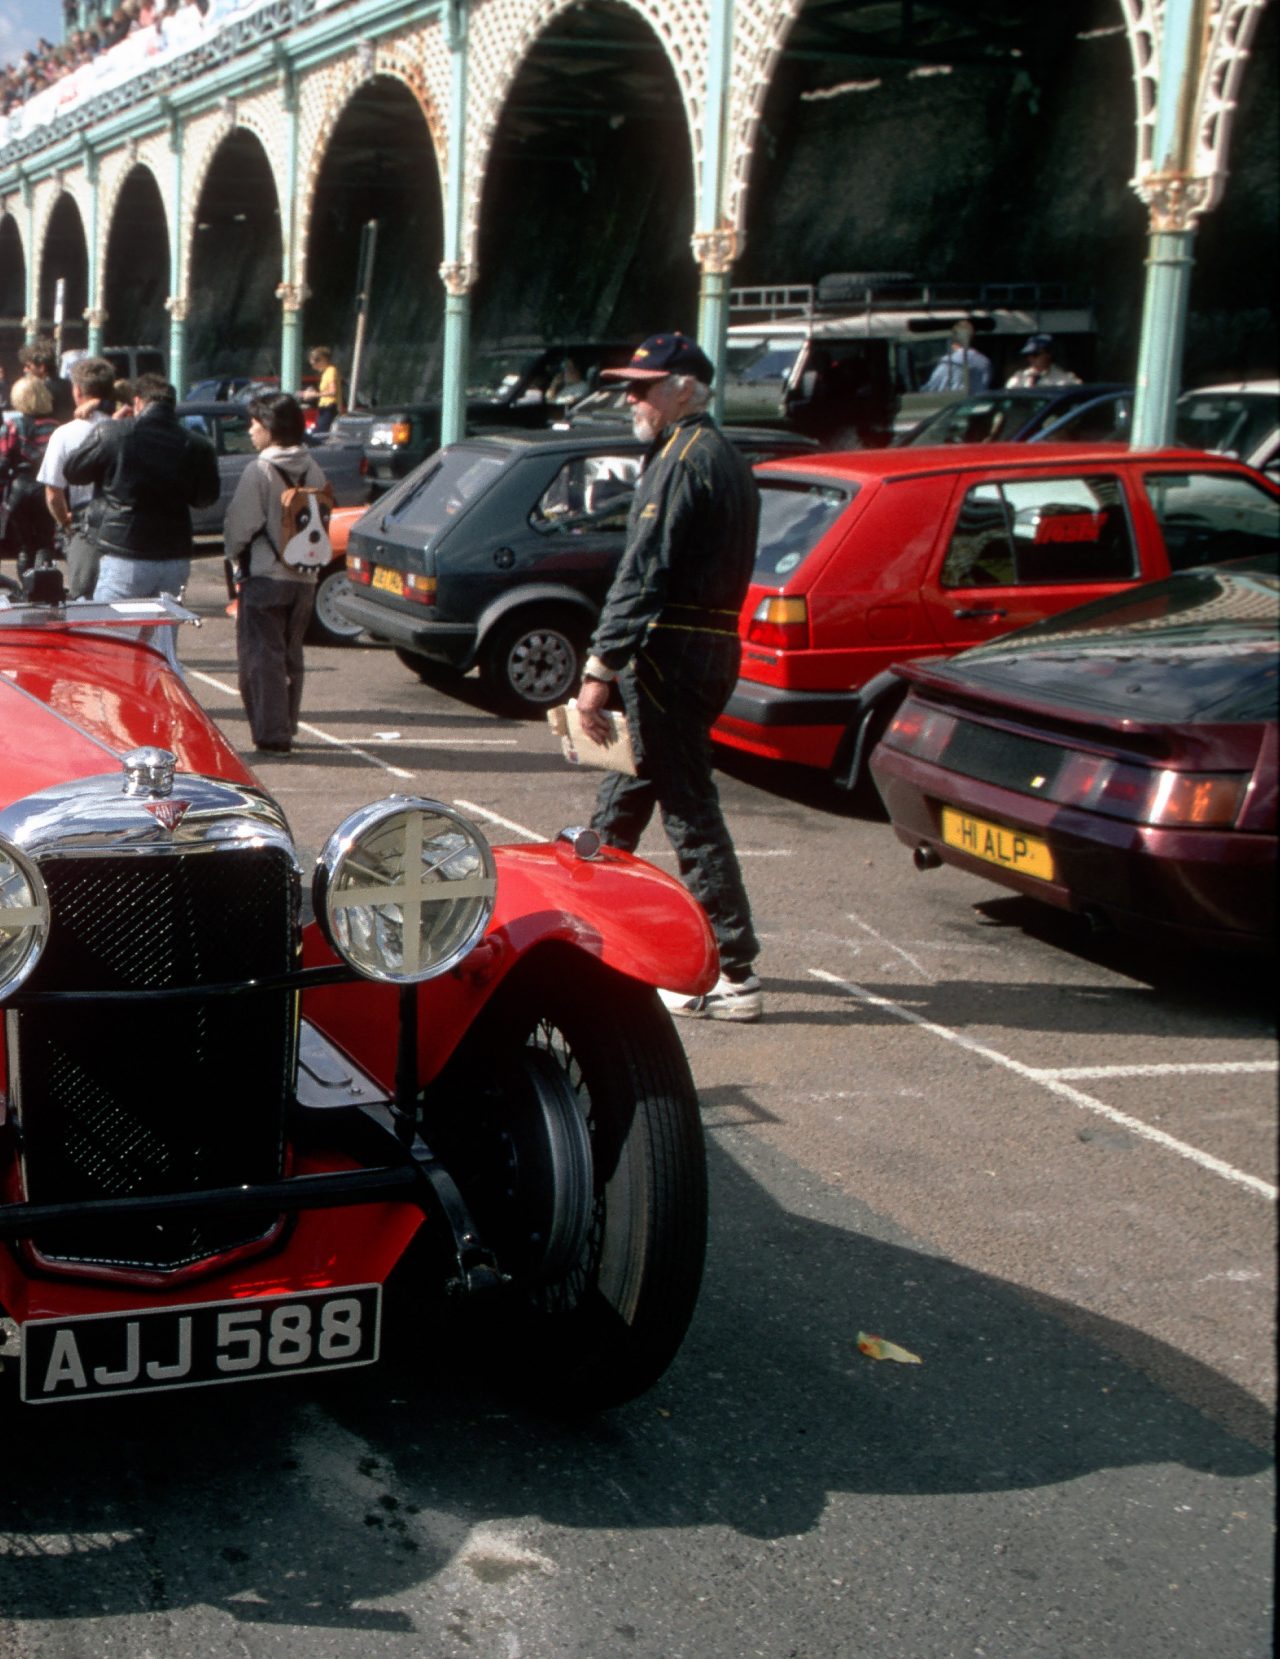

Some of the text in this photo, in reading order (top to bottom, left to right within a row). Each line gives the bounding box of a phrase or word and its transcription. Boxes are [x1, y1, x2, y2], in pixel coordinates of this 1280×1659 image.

[984, 828, 1028, 864] ALP
[43, 1298, 362, 1392] AJJ 588
